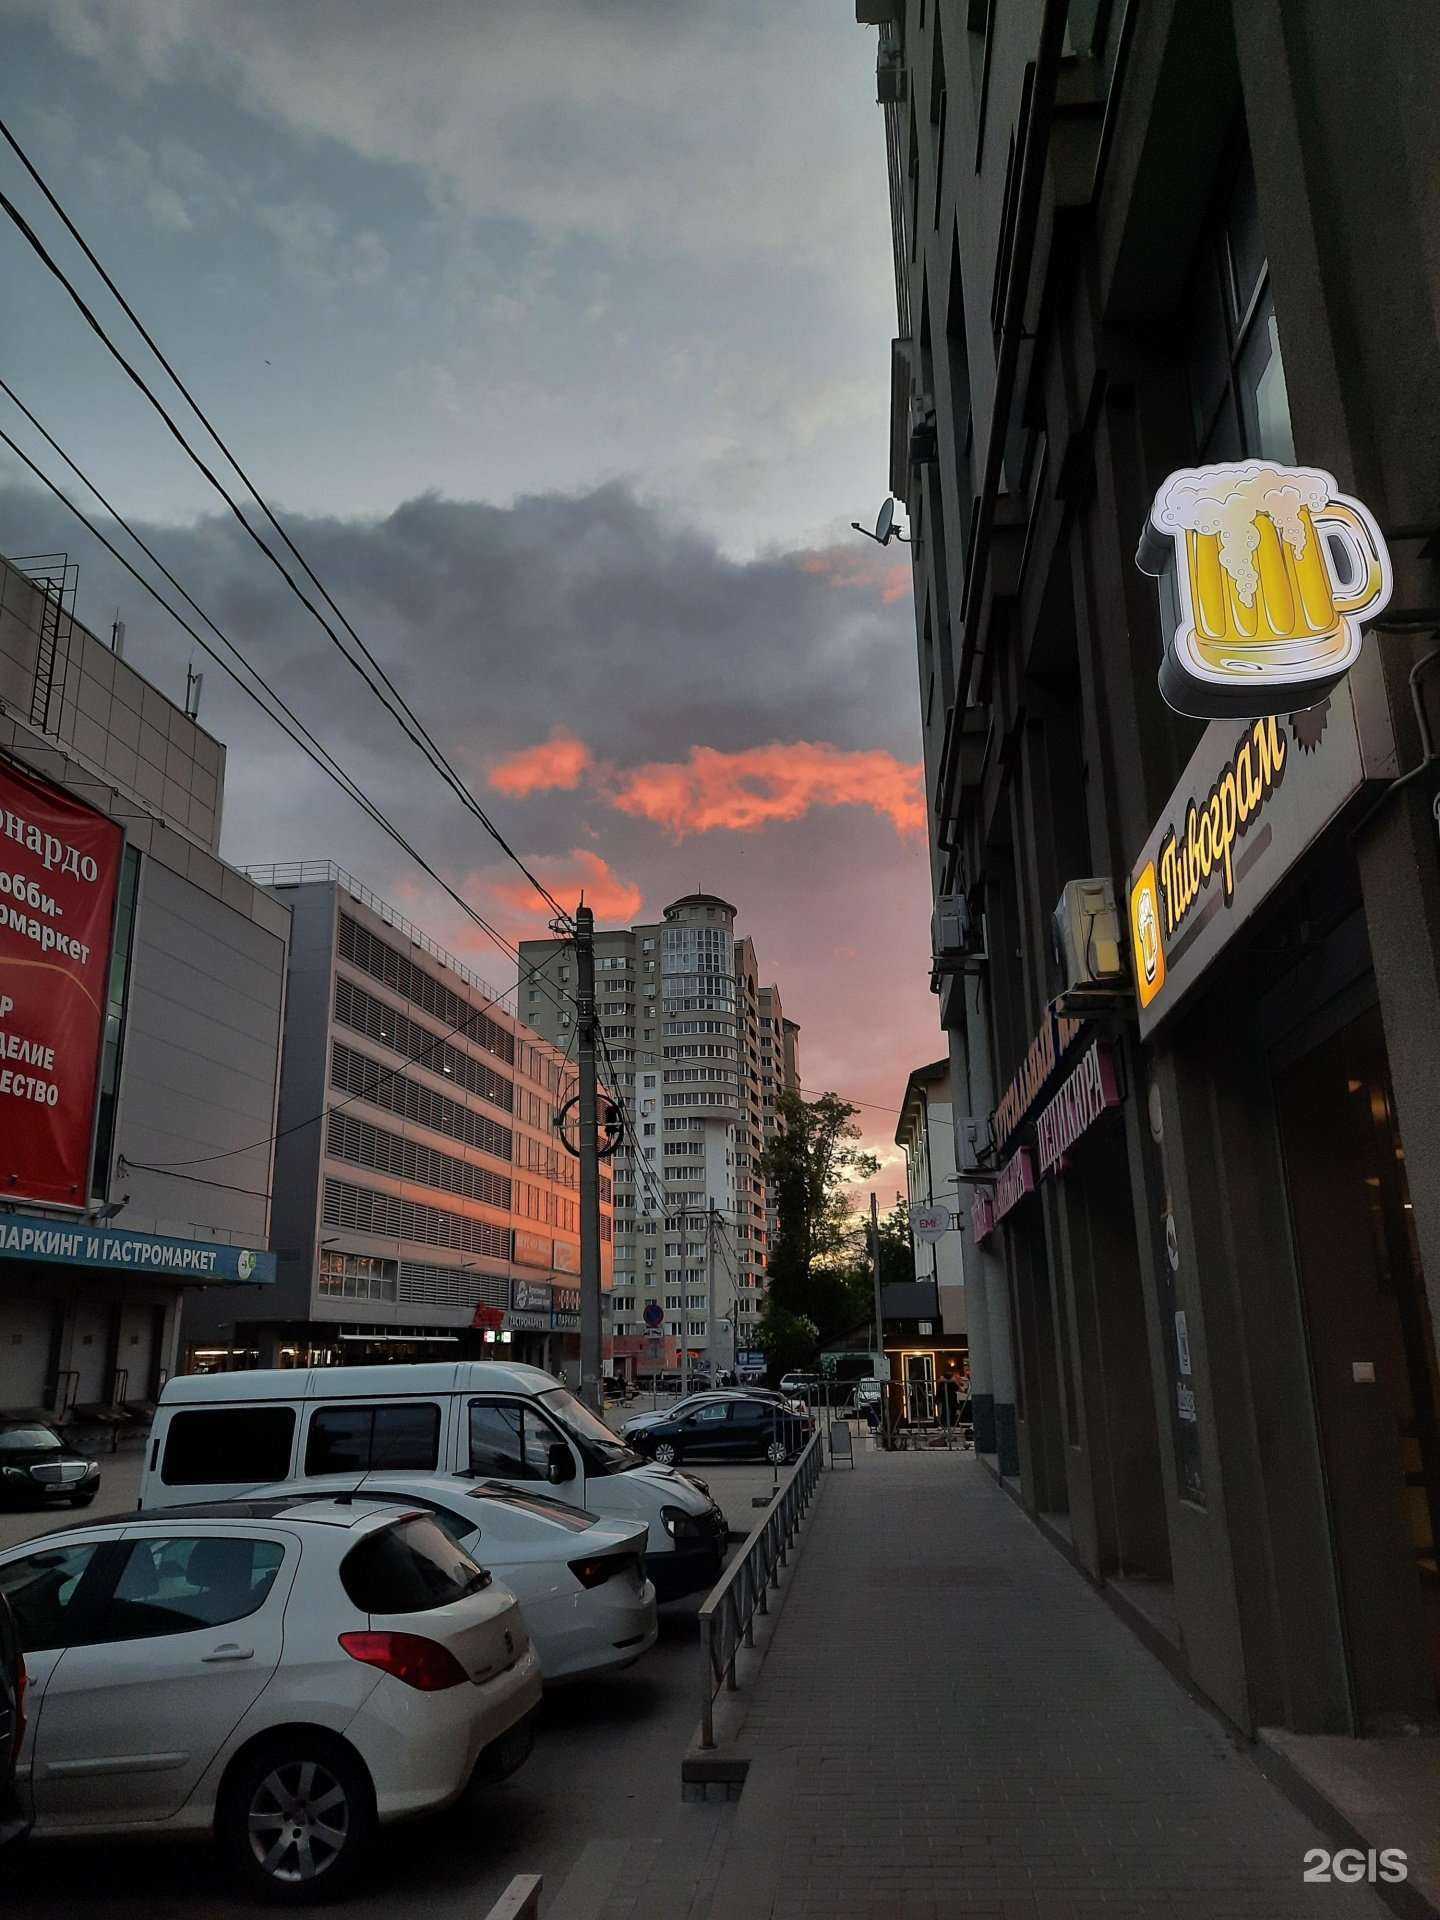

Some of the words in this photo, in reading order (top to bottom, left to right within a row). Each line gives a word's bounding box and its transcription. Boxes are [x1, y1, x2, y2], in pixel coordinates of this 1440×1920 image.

[0, 808, 98, 883] нардо
[1161, 715, 1286, 934] Пивограм
[86, 1236, 99, 1260] И
[102, 1239, 217, 1271] ГАСТРОМАРКЕТ
